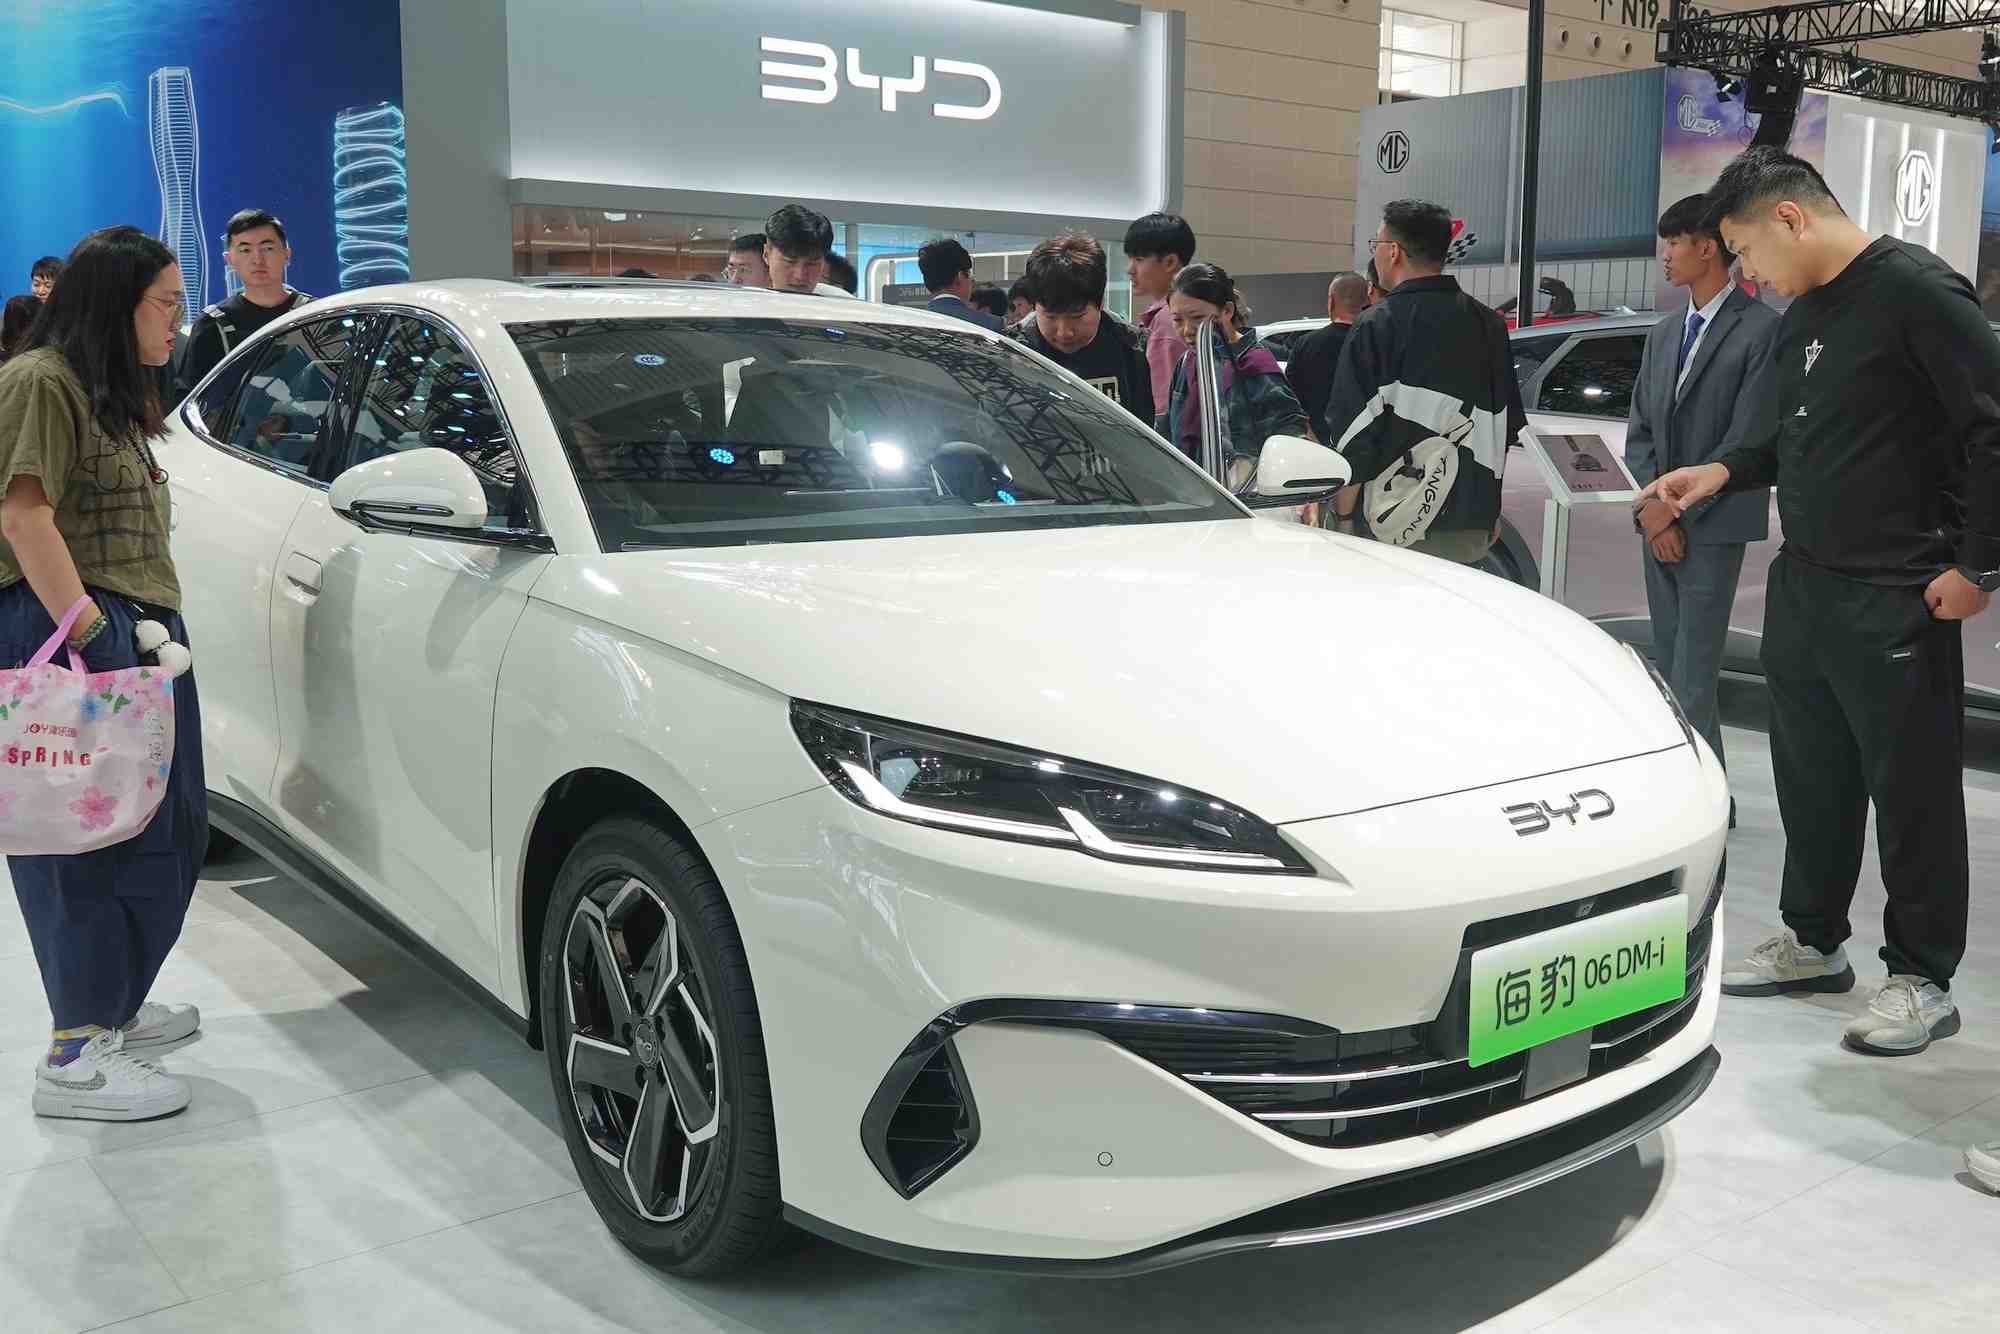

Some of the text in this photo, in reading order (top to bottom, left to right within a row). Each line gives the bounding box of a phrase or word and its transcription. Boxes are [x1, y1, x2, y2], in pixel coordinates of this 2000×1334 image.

[1621, 0, 1660, 30] N19
[760, 36, 1002, 120] BYD
[1379, 133, 1408, 171] MG
[1898, 154, 1932, 222] MG
[8, 747, 91, 767] SPRING
[1501, 788, 1615, 836] BYD
